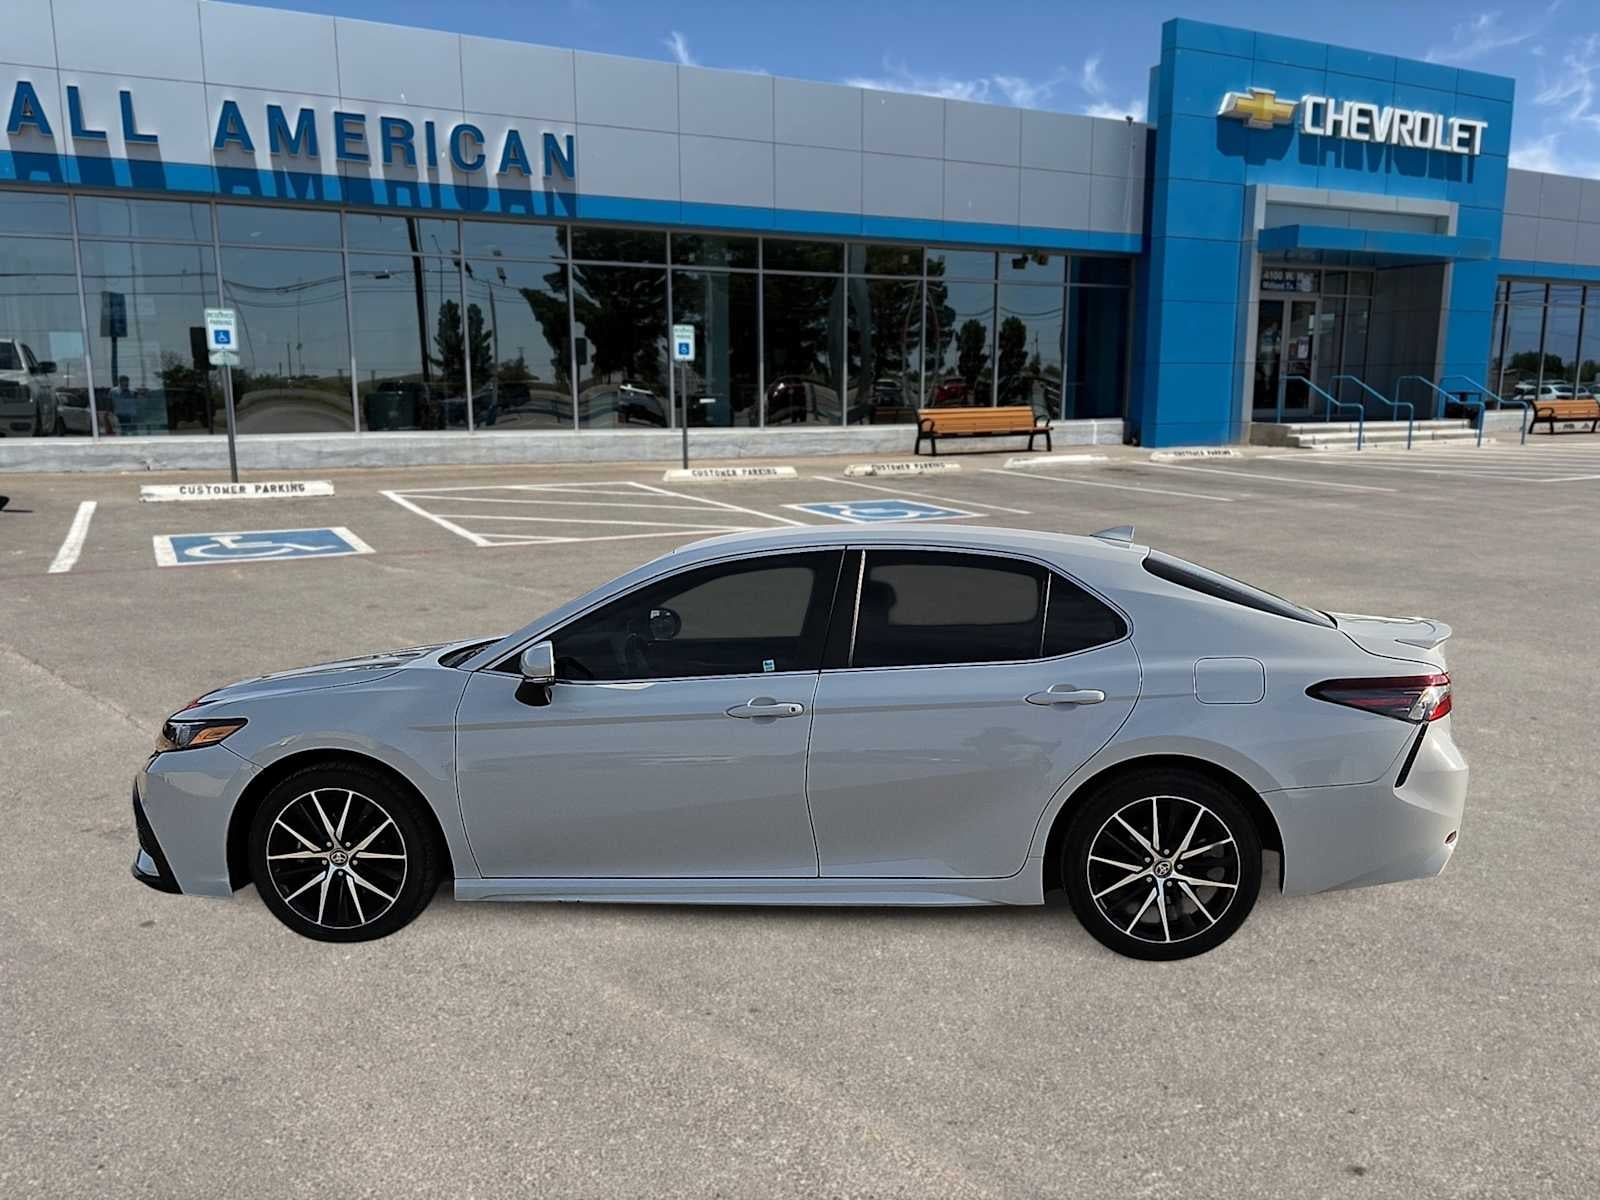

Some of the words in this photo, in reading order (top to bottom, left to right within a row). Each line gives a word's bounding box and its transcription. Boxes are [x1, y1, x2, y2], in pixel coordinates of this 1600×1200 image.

[7, 80, 159, 144] ALL
[213, 99, 576, 180] AMERICAN
[1300, 94, 1488, 156] CHEVROLET
[179, 485, 246, 496] CUSTOMER
[254, 483, 306, 494] PARKING
[692, 468, 737, 477] CUSTOMER
[742, 467, 778, 476] PARKING
